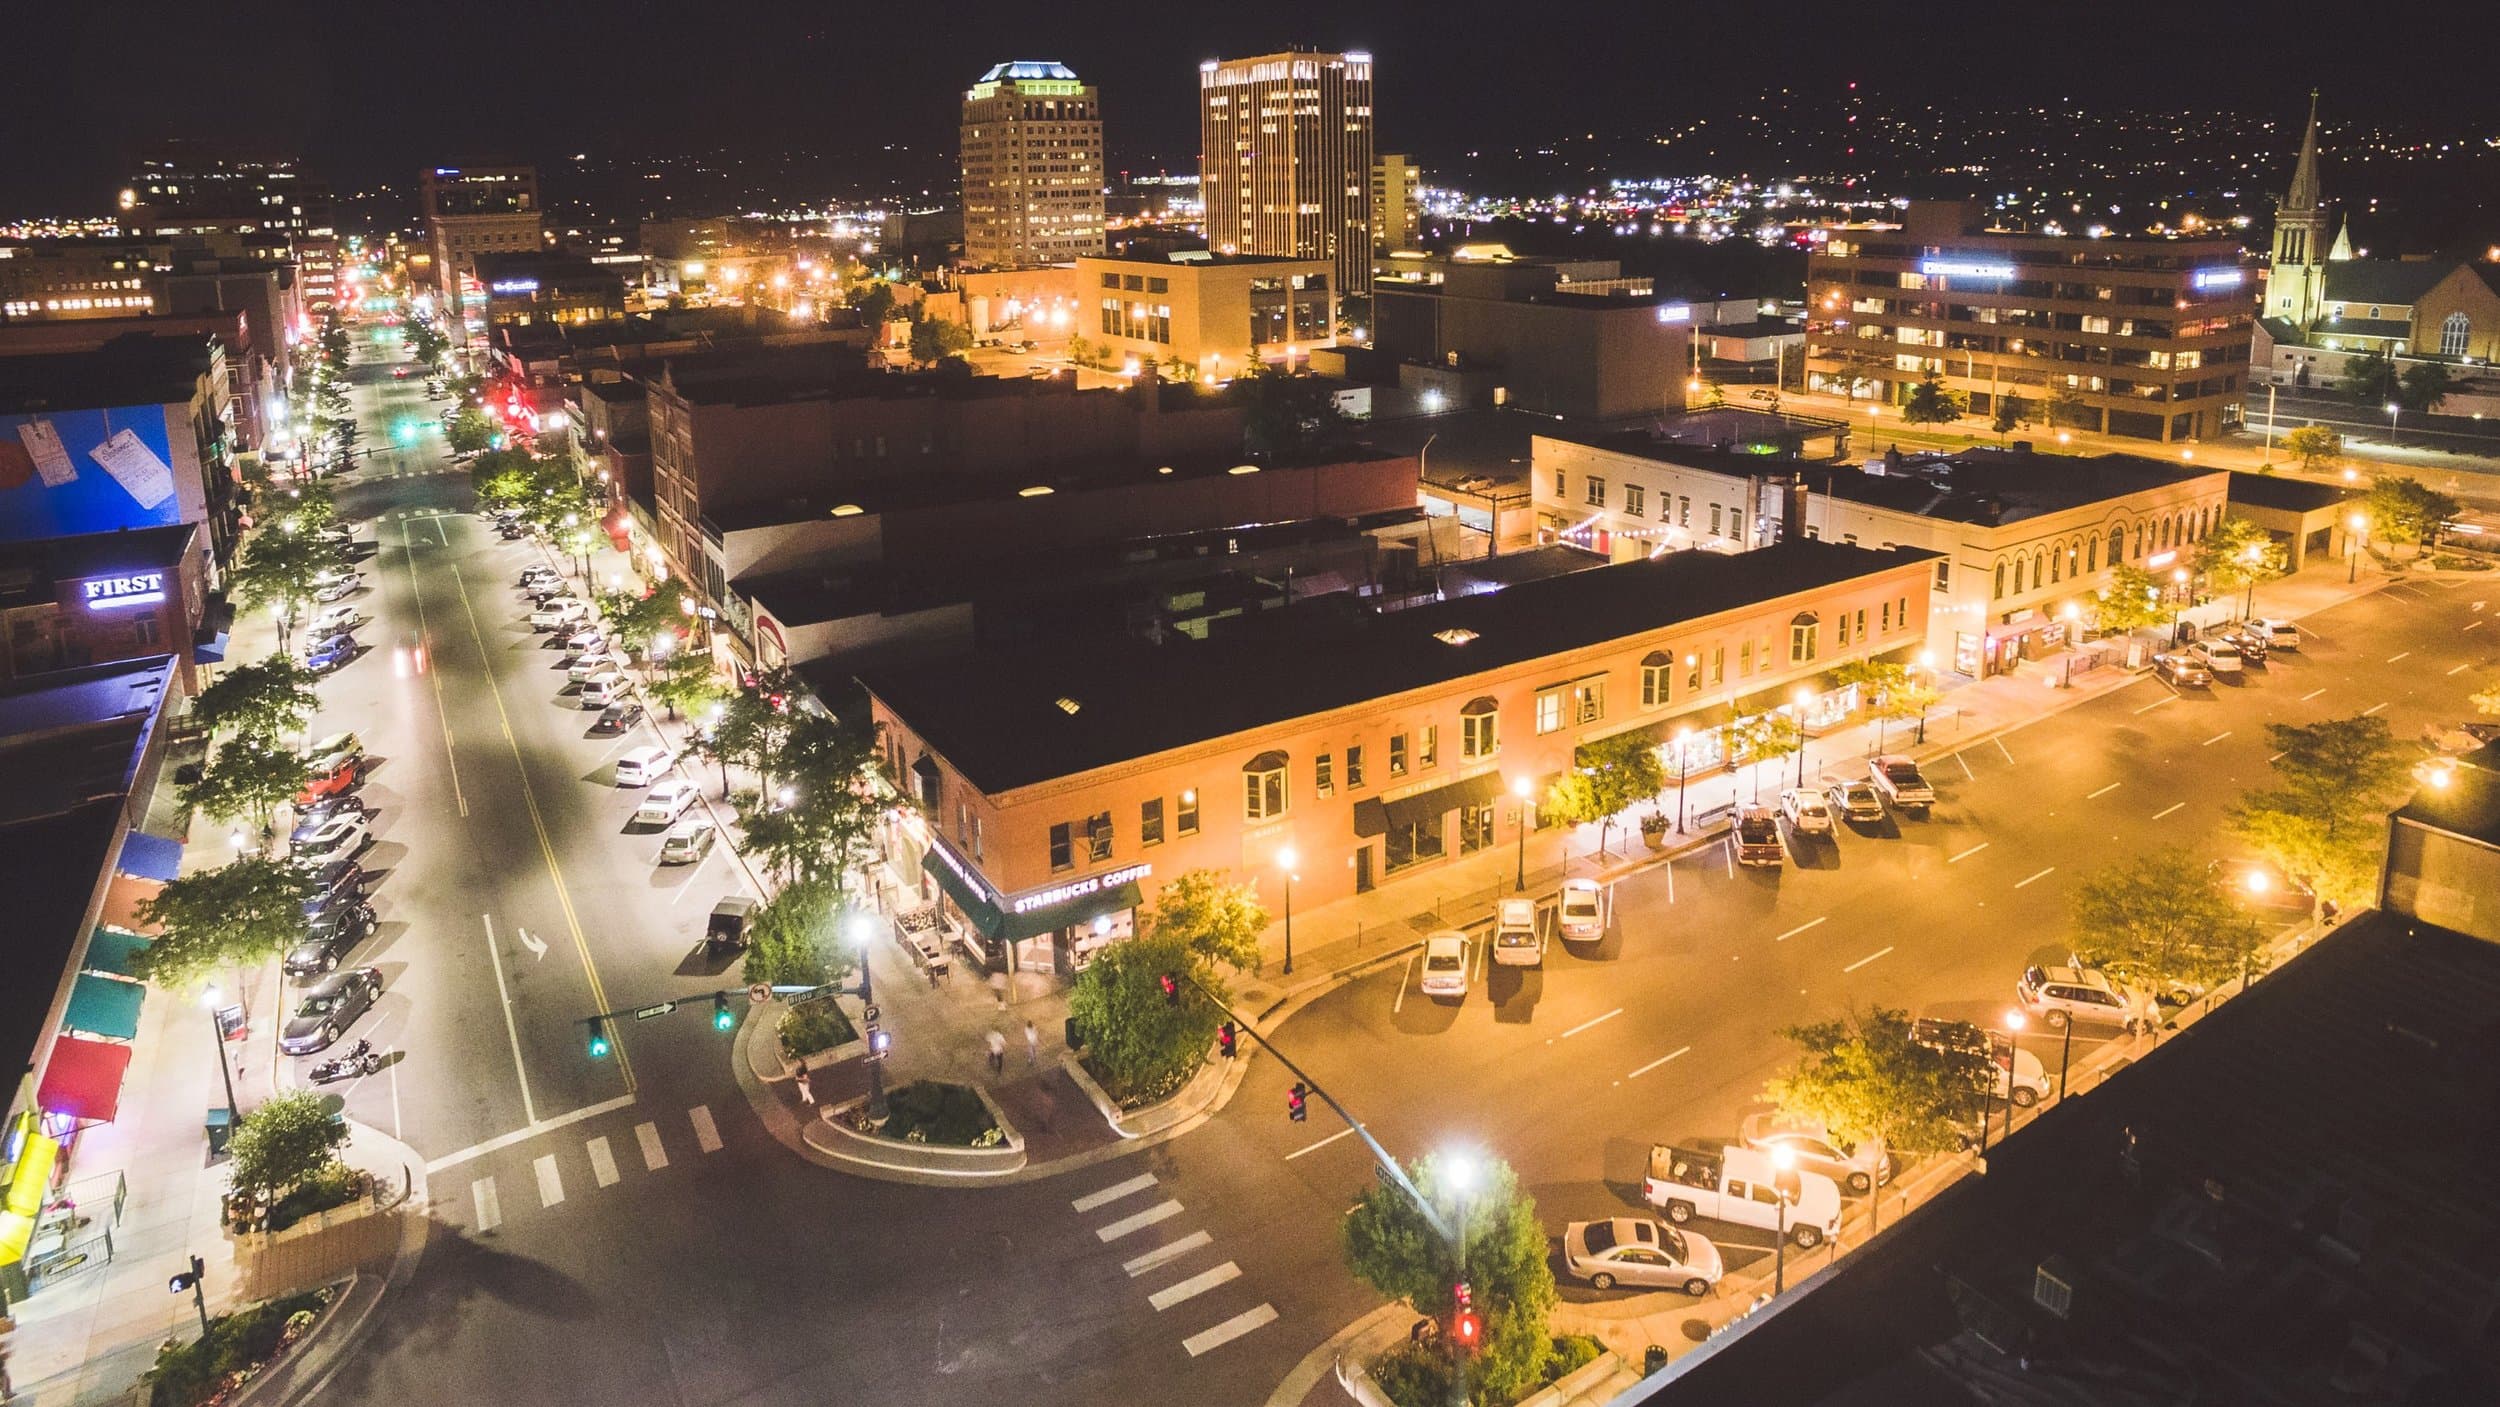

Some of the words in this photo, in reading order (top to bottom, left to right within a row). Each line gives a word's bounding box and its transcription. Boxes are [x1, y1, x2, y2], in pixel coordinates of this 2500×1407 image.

[84, 574, 162, 598] FIRST
[1014, 878, 1099, 914] STARBUCKS
[1103, 864, 1152, 888] COFFEE
